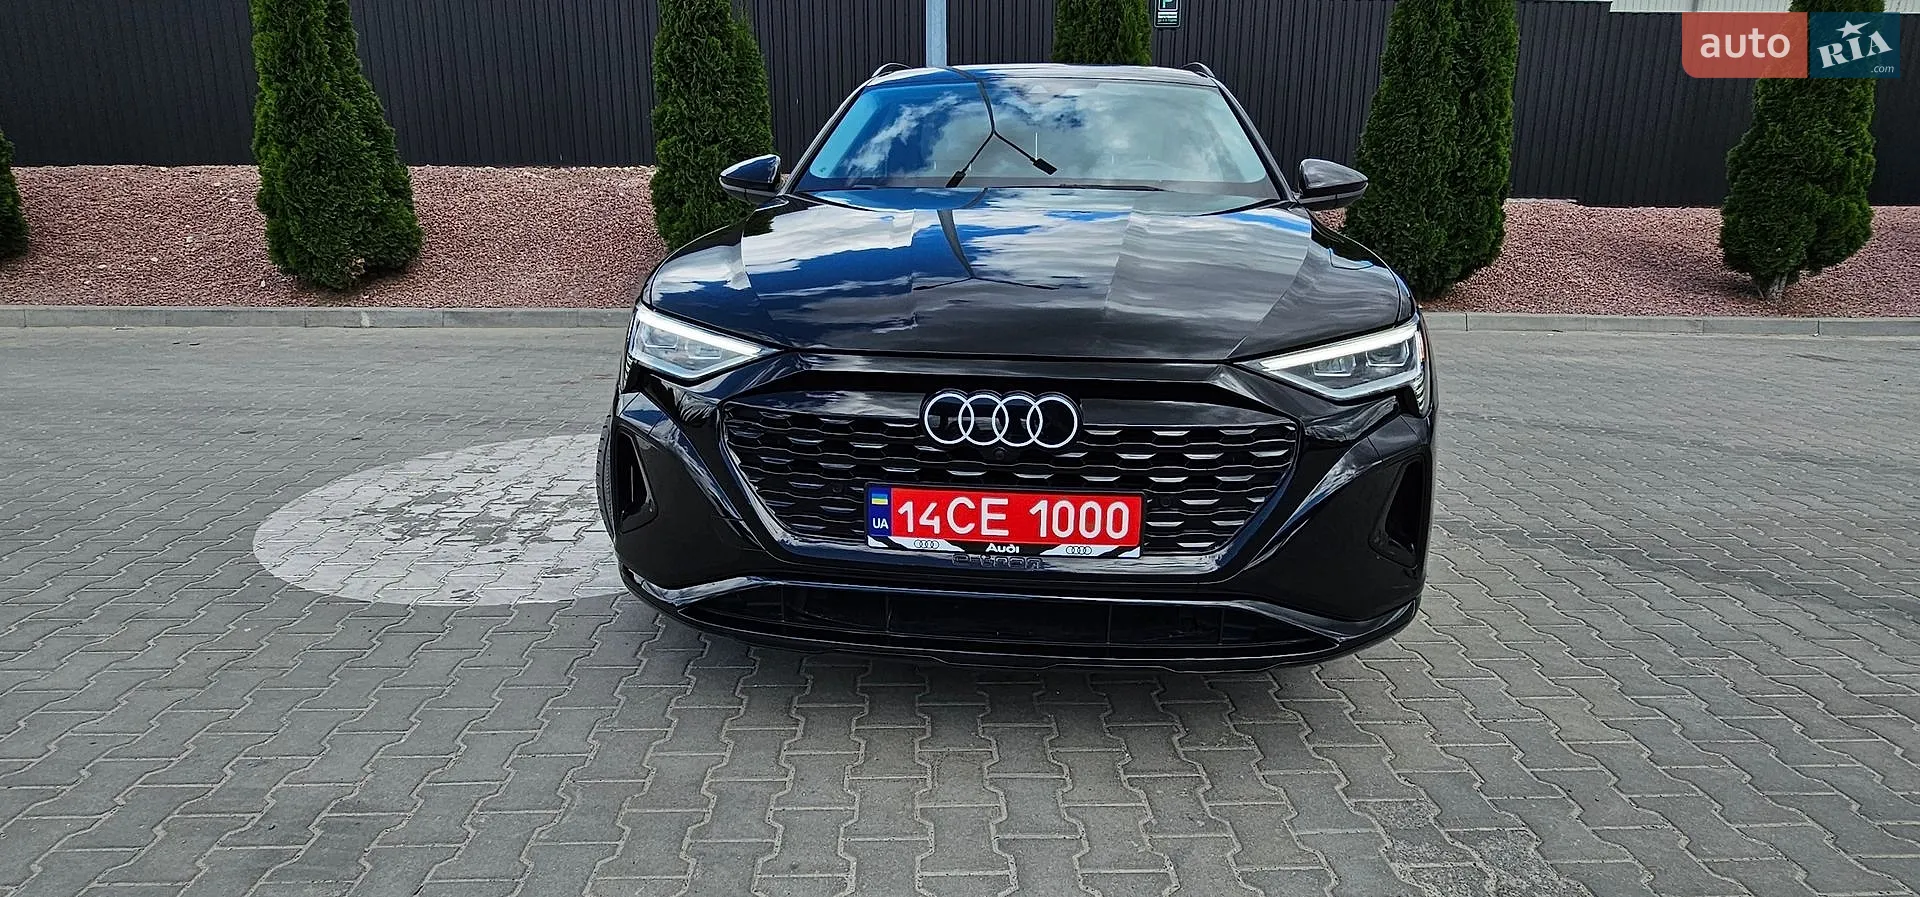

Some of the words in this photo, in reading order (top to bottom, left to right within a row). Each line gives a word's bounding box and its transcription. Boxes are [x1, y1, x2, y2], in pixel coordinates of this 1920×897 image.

[872, 517, 889, 529] UA
[1029, 499, 1131, 539] 1000
[985, 543, 1020, 554] Audi
